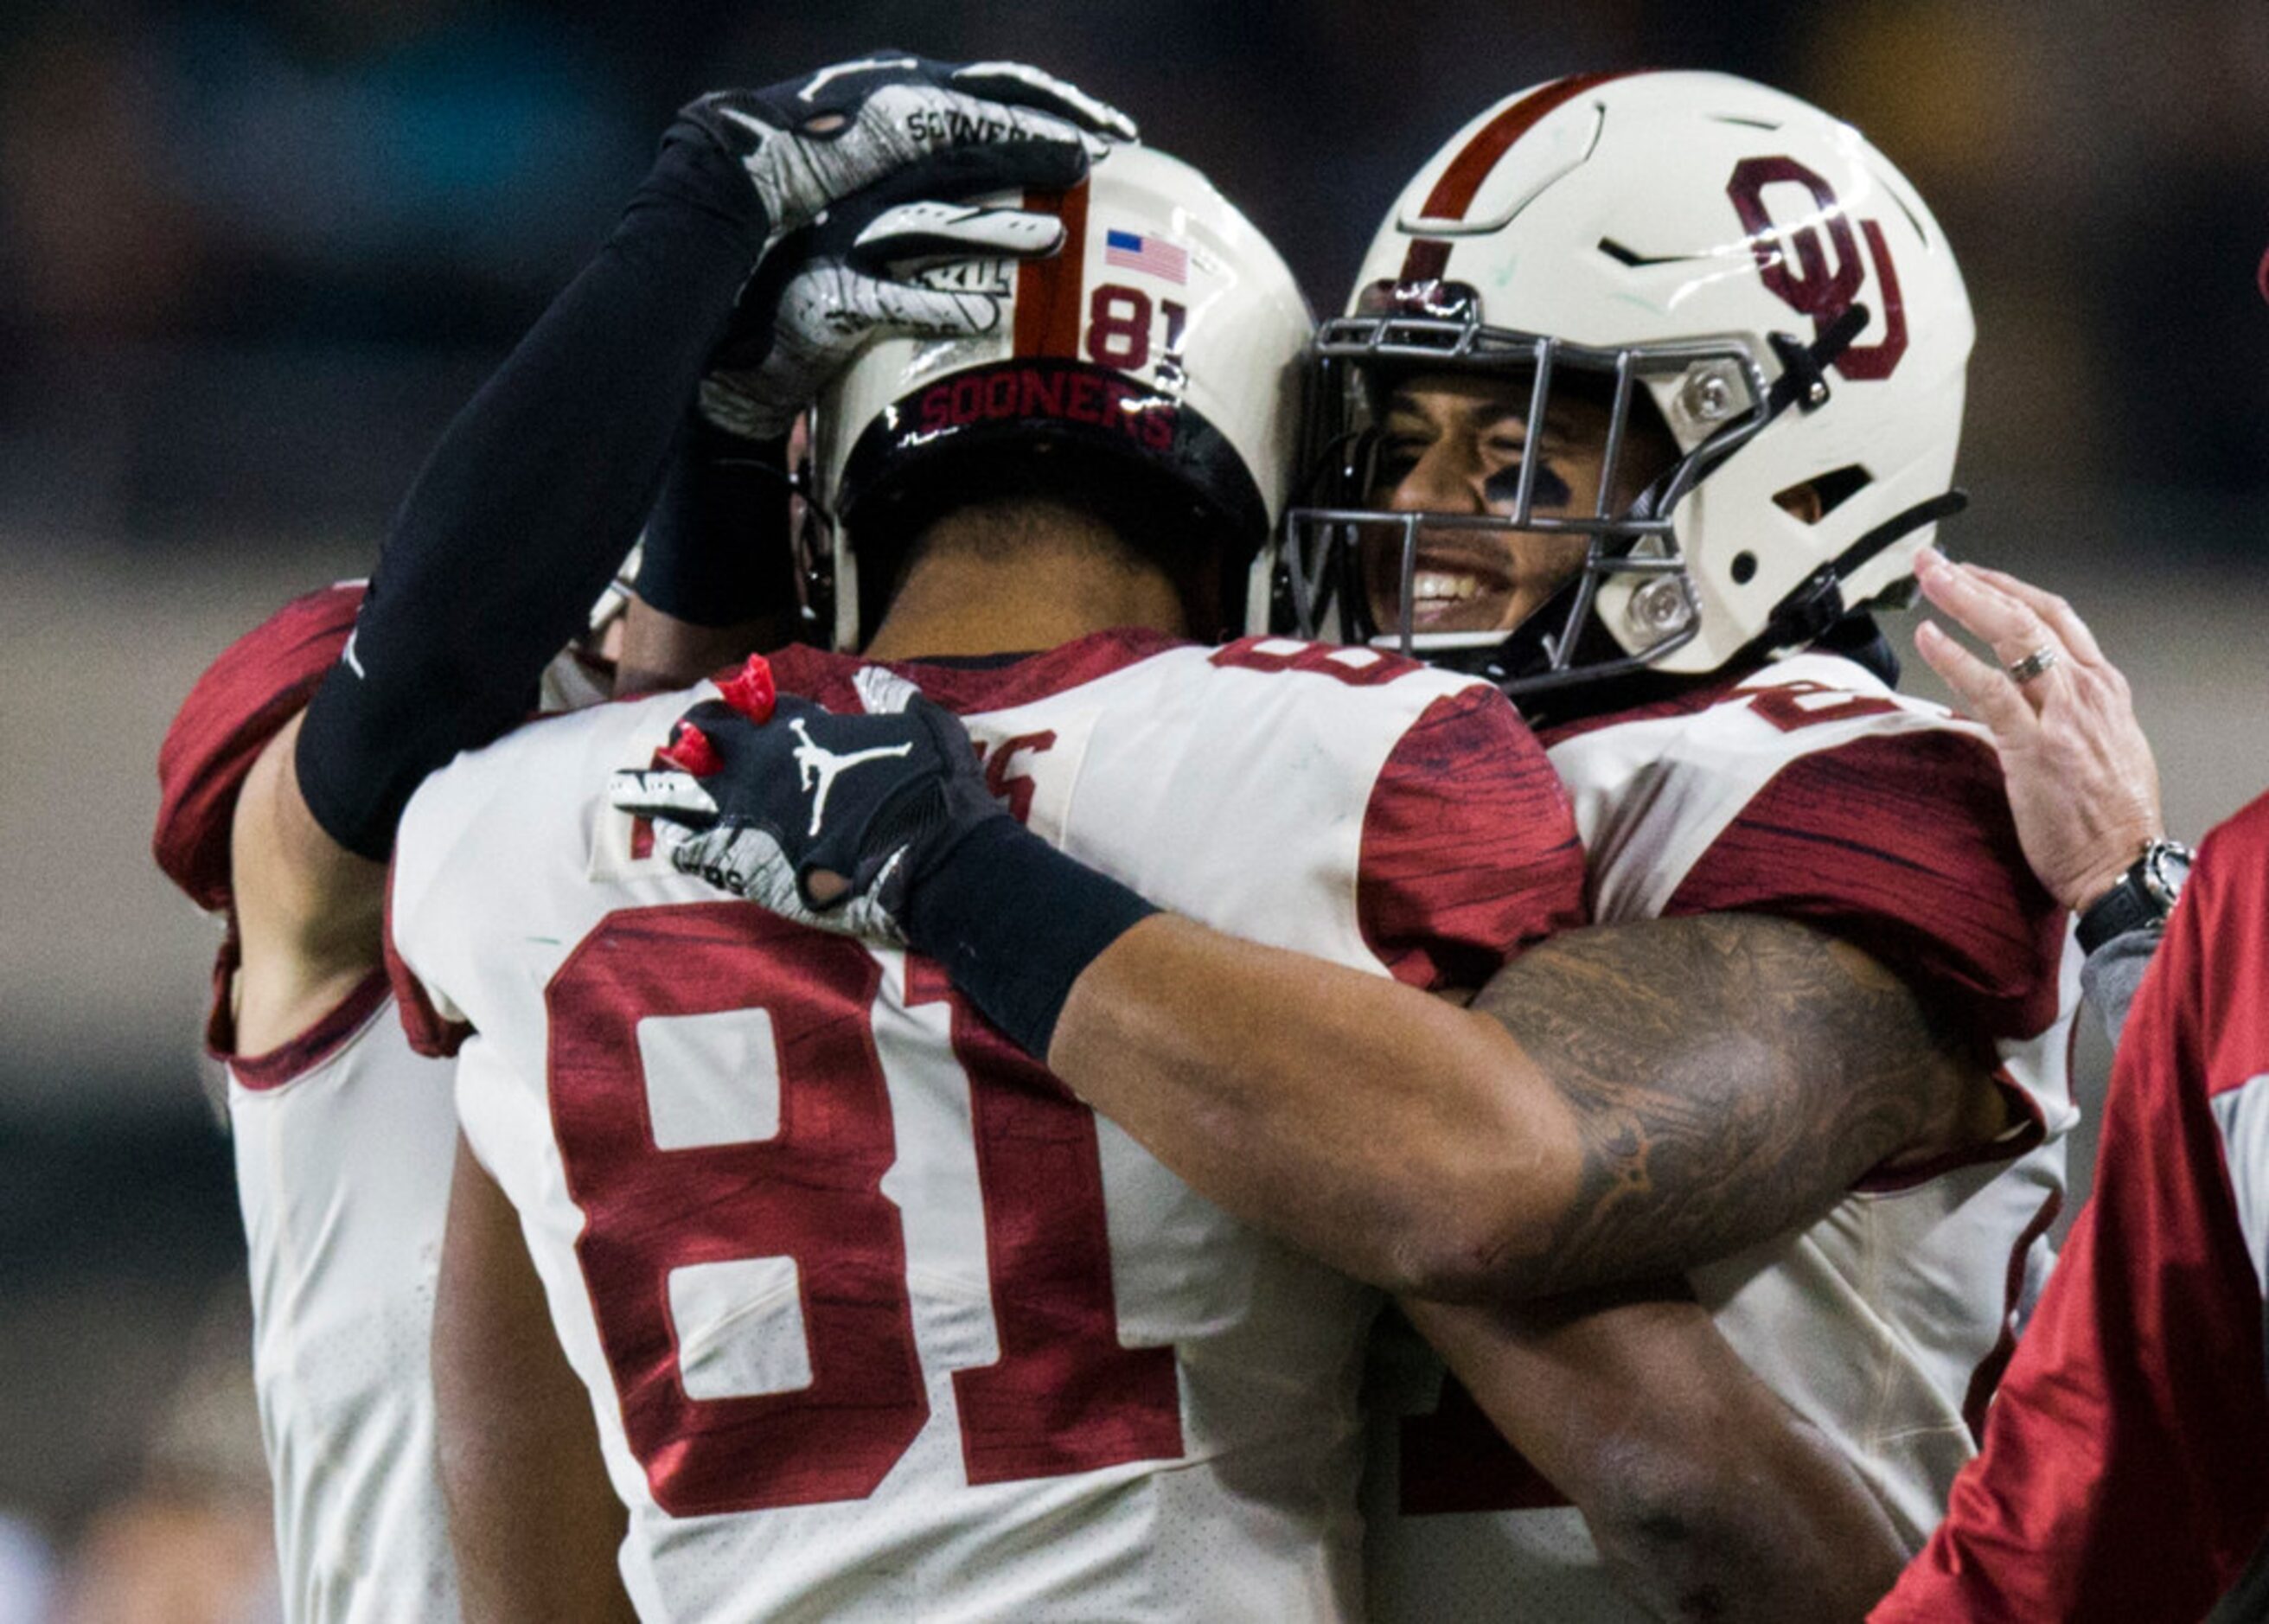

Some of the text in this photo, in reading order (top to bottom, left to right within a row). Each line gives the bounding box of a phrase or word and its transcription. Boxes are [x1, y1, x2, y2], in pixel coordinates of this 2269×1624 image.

[1086, 283, 1187, 390] 81
[1726, 155, 1908, 380] OU
[918, 369, 1174, 451] SOONERS
[545, 899, 1186, 1519] 81
